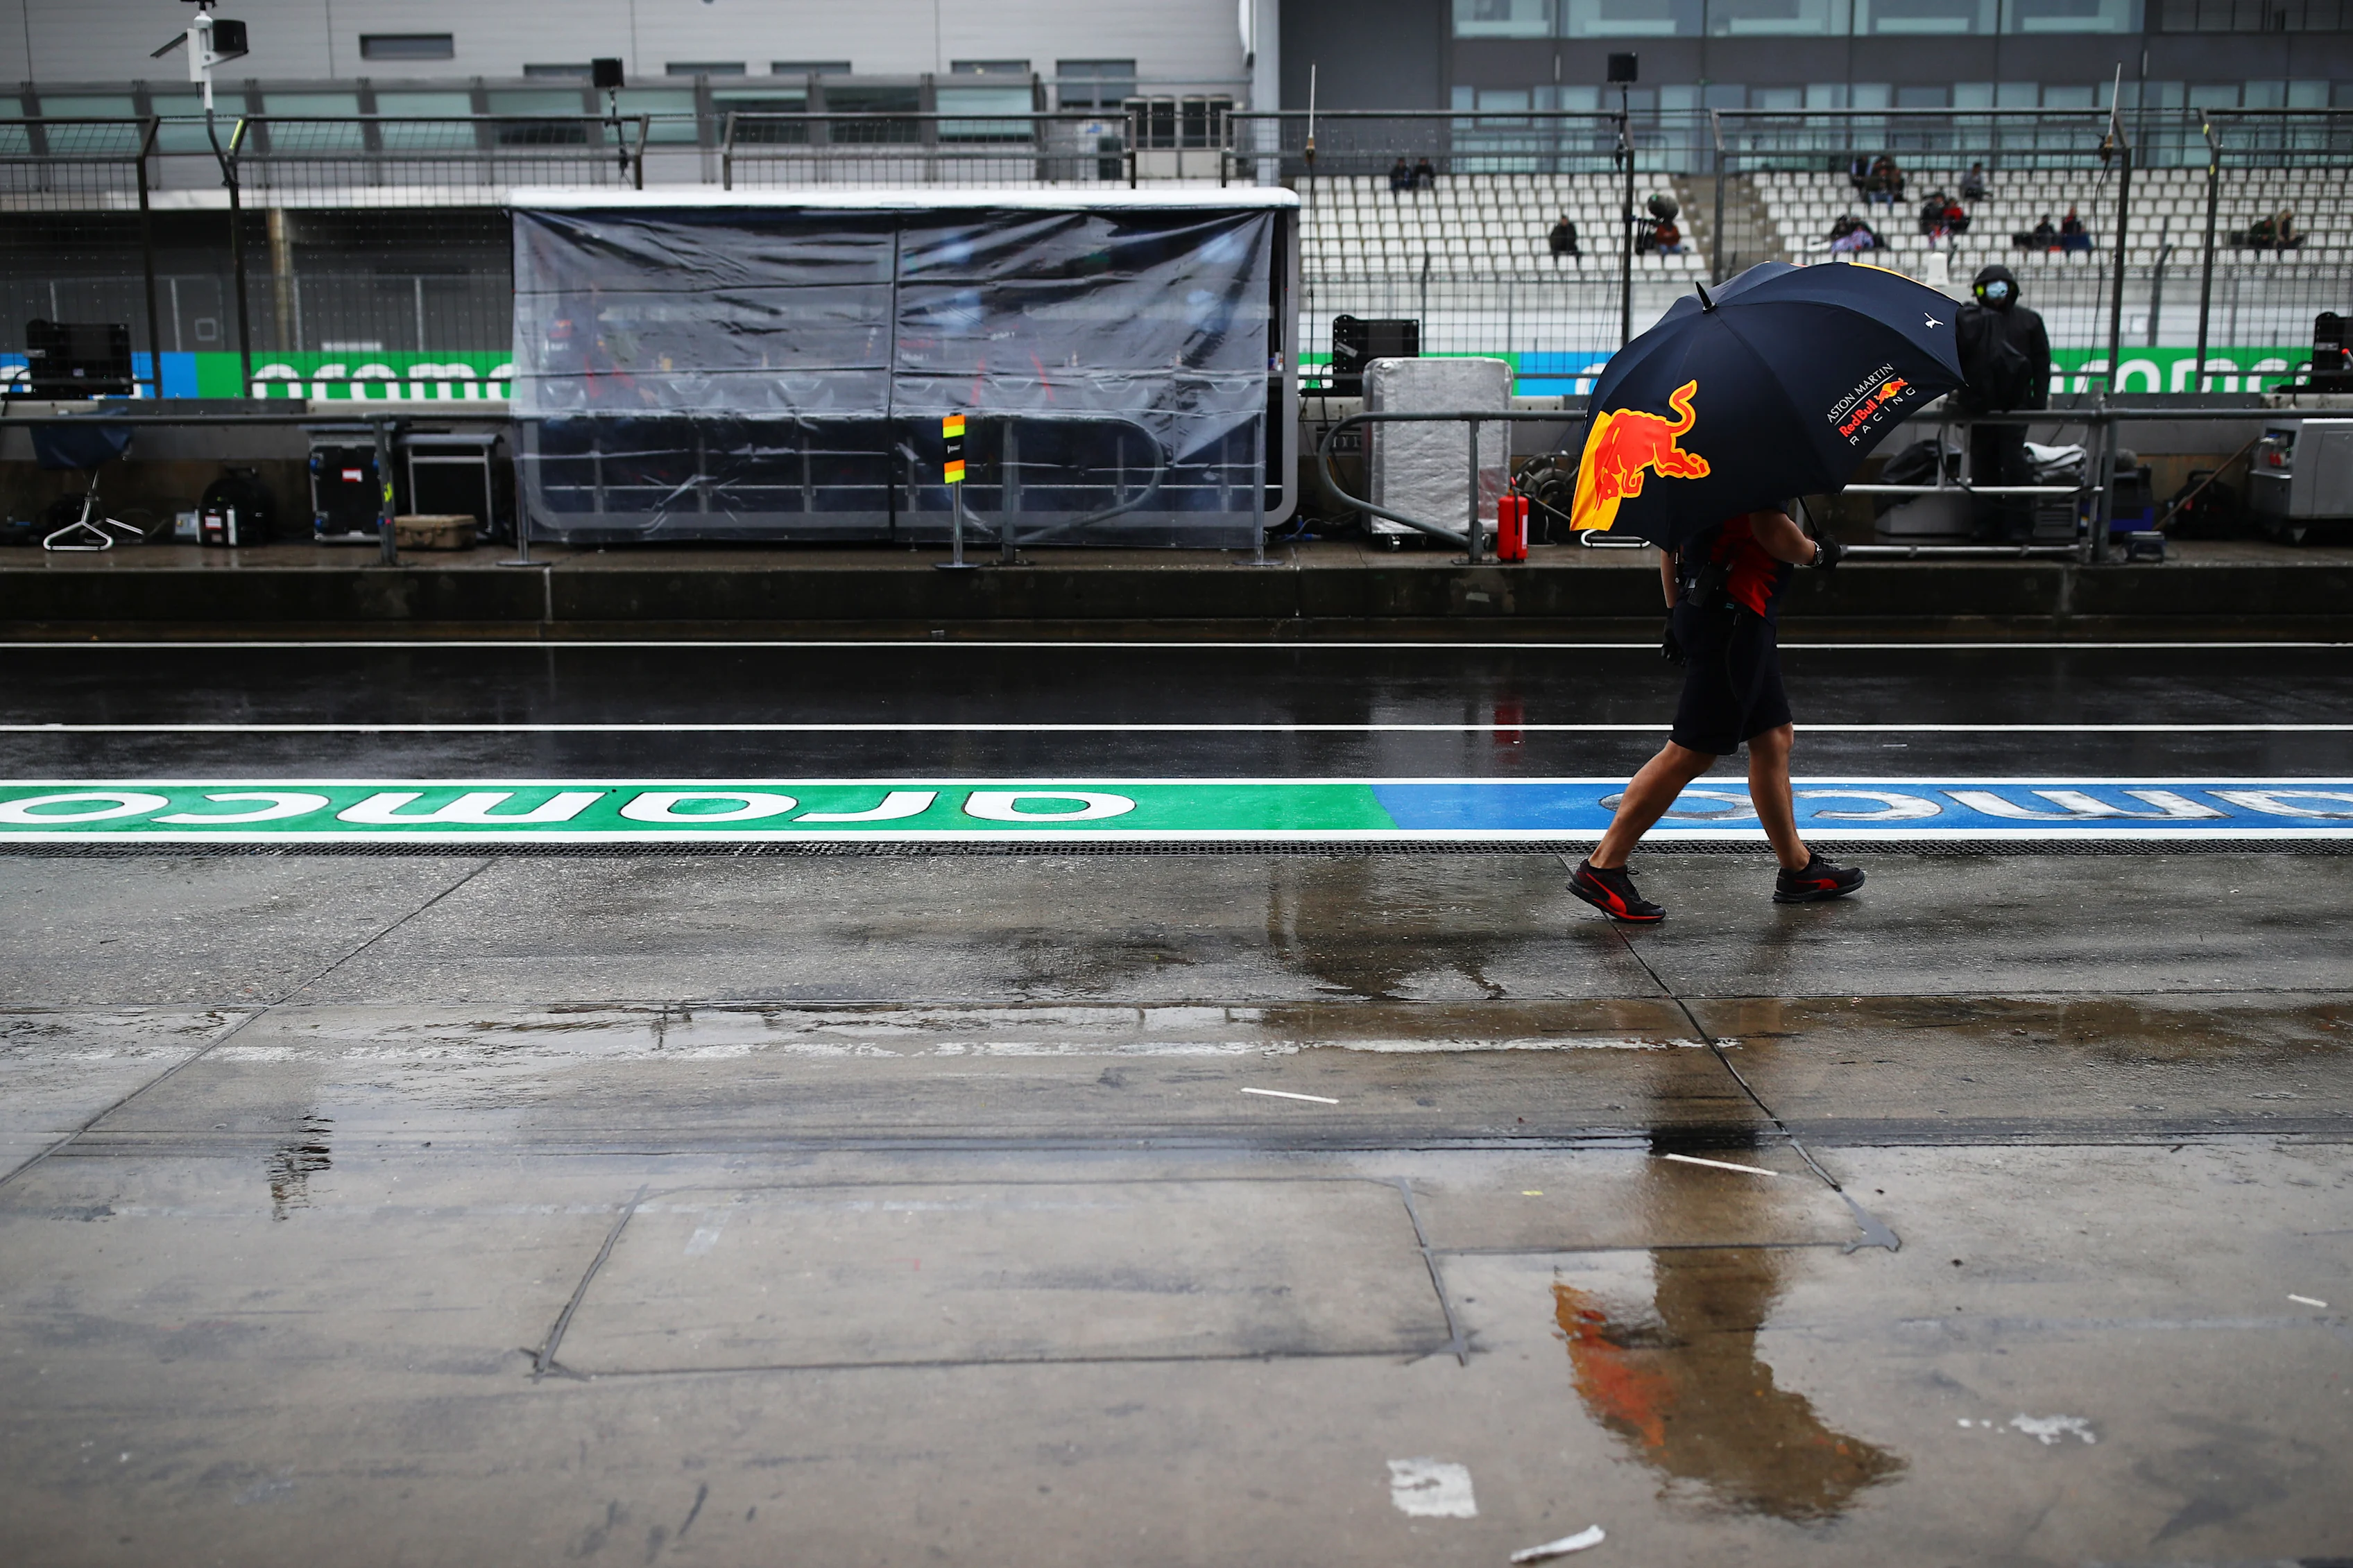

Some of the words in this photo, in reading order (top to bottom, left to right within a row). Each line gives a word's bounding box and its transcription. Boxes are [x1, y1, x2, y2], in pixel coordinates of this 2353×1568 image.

[1826, 393, 1856, 423] ASTON
[1854, 363, 1894, 396] MARTIN
[1849, 387, 1916, 445] RACING
[0, 792, 1136, 823] aramco
